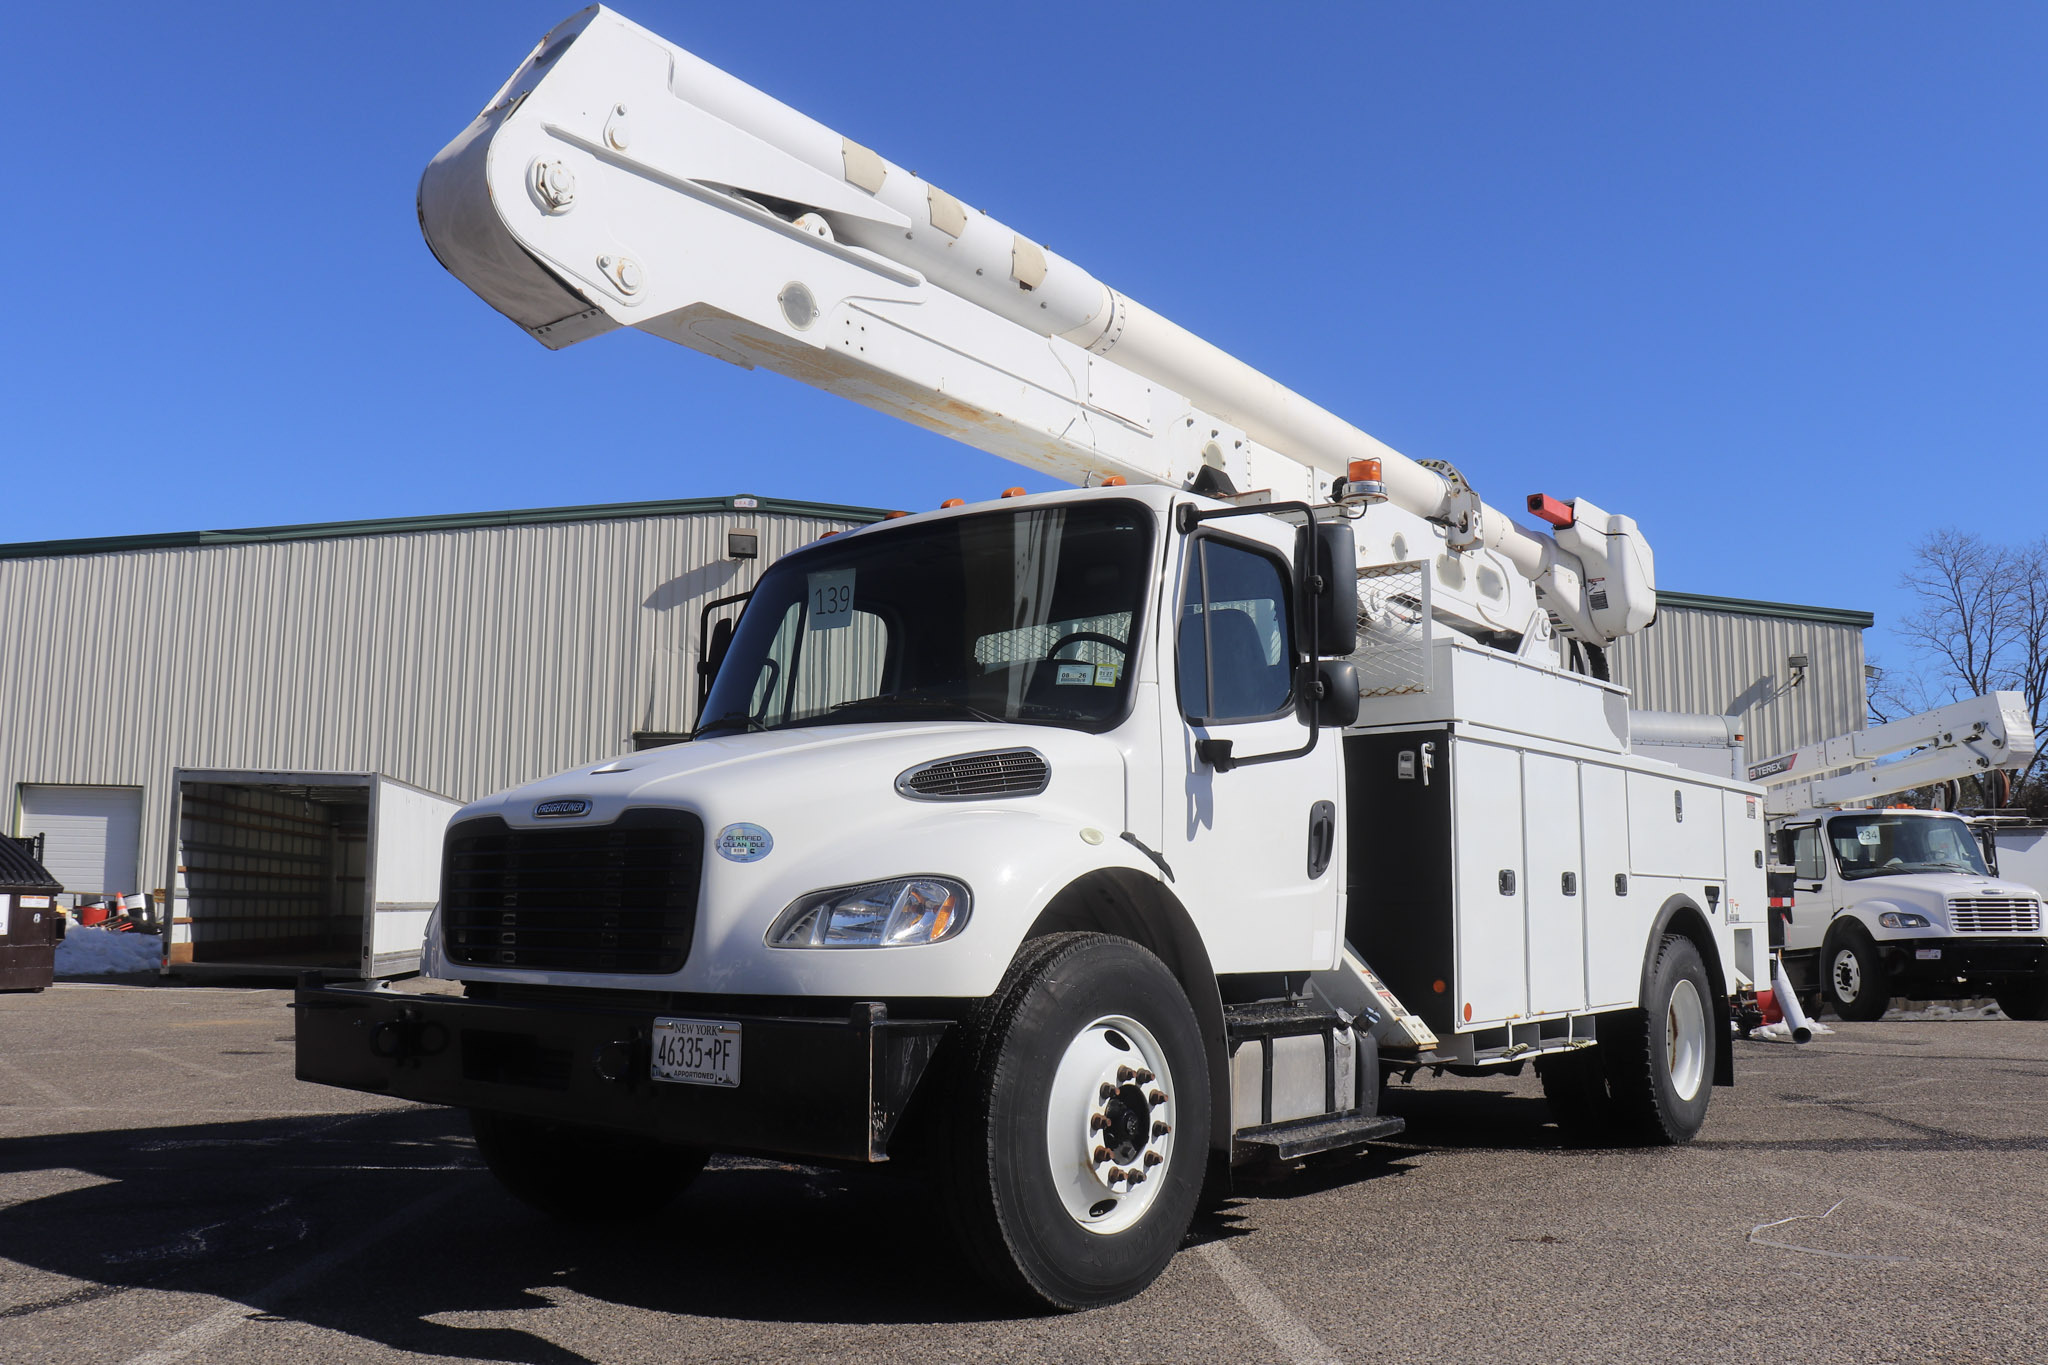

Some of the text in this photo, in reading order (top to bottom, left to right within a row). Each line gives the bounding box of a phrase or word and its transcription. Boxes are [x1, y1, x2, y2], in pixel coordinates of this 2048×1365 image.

[815, 585, 850, 615] 139
[1757, 761, 1782, 776] TEREX
[538, 802, 585, 813] FREIGHTLINER
[33, 912, 41, 923] 8
[675, 1023, 719, 1036] NEW YORK
[658, 1035, 703, 1068] 46335
[673, 1070, 714, 1079] APPORTIONED
